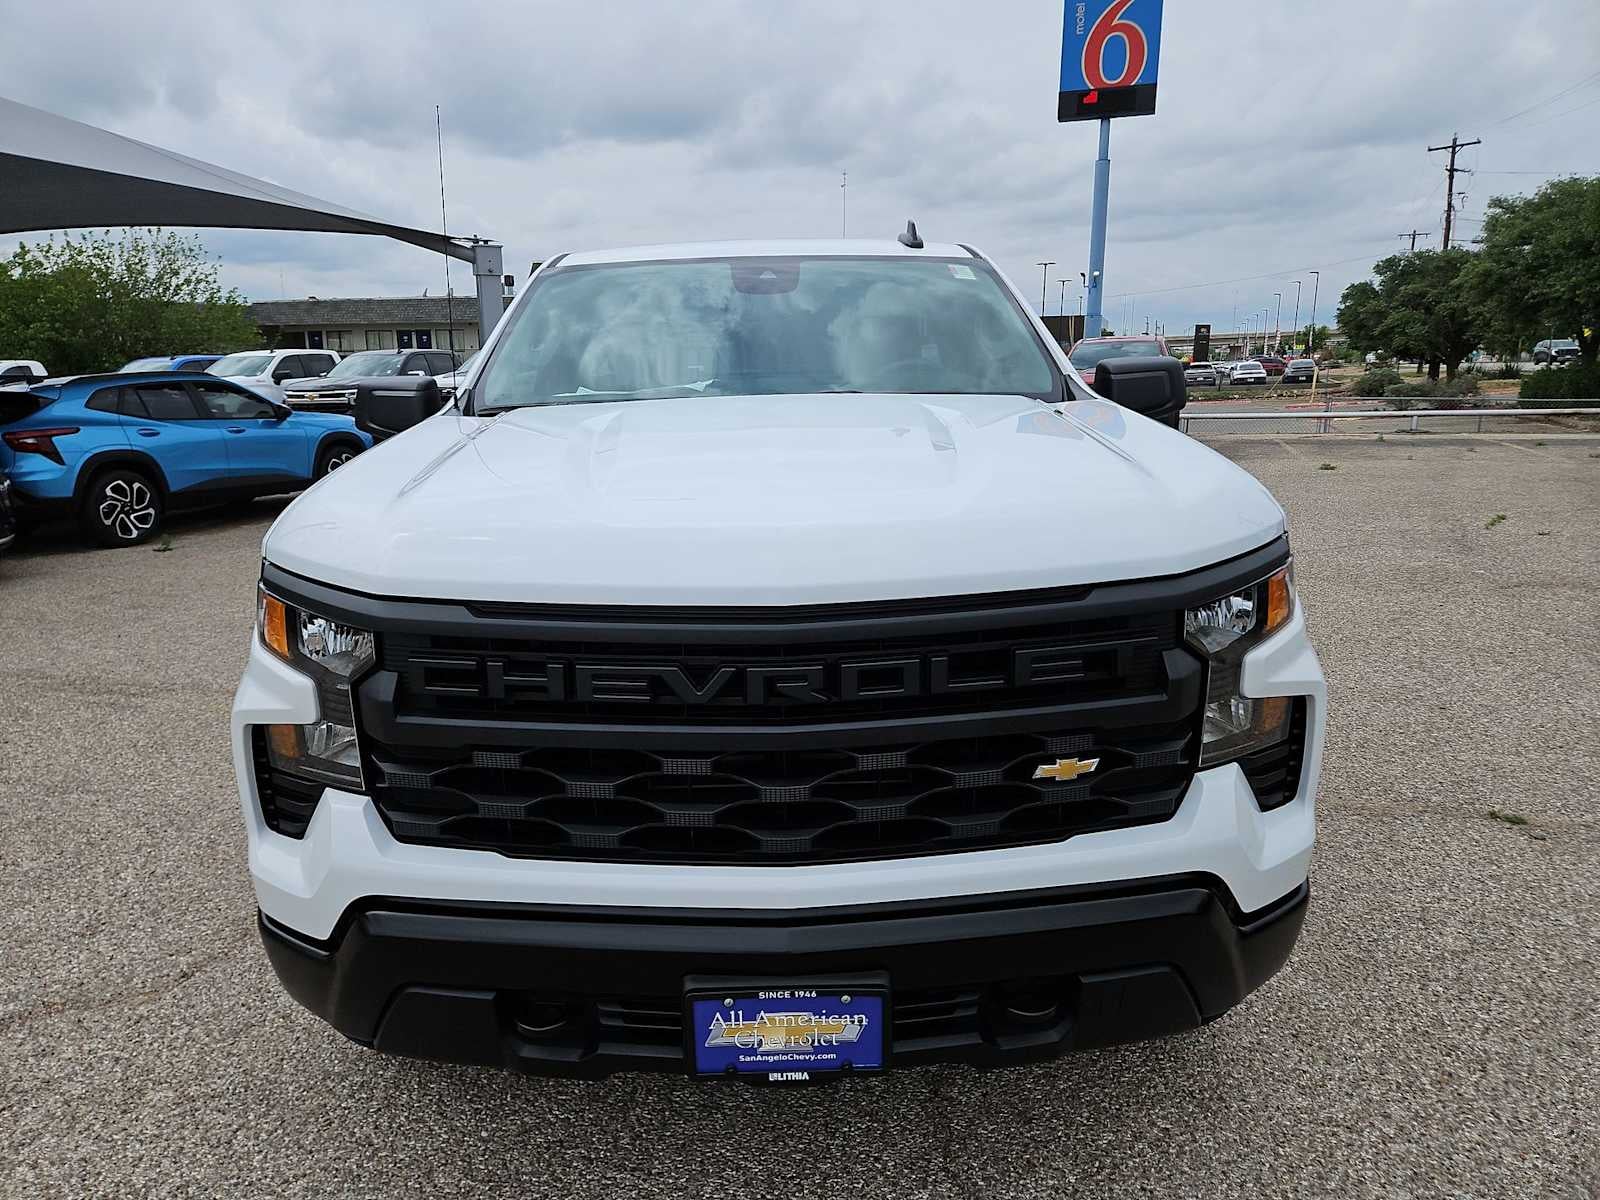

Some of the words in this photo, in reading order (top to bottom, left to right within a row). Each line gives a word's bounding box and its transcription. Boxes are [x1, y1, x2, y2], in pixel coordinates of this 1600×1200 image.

[1075, 2, 1086, 35] motel
[1081, 0, 1148, 89] 6
[406, 636, 1160, 706] CHEVROLET
[758, 991, 791, 1000] SINCE
[794, 990, 817, 999] 1946
[708, 1010, 744, 1030] All
[753, 1009, 869, 1028] American
[734, 1028, 840, 1049] Chevrolet
[738, 1053, 837, 1063] SanAngeloChevy.com
[778, 1071, 810, 1081] LITHIA
